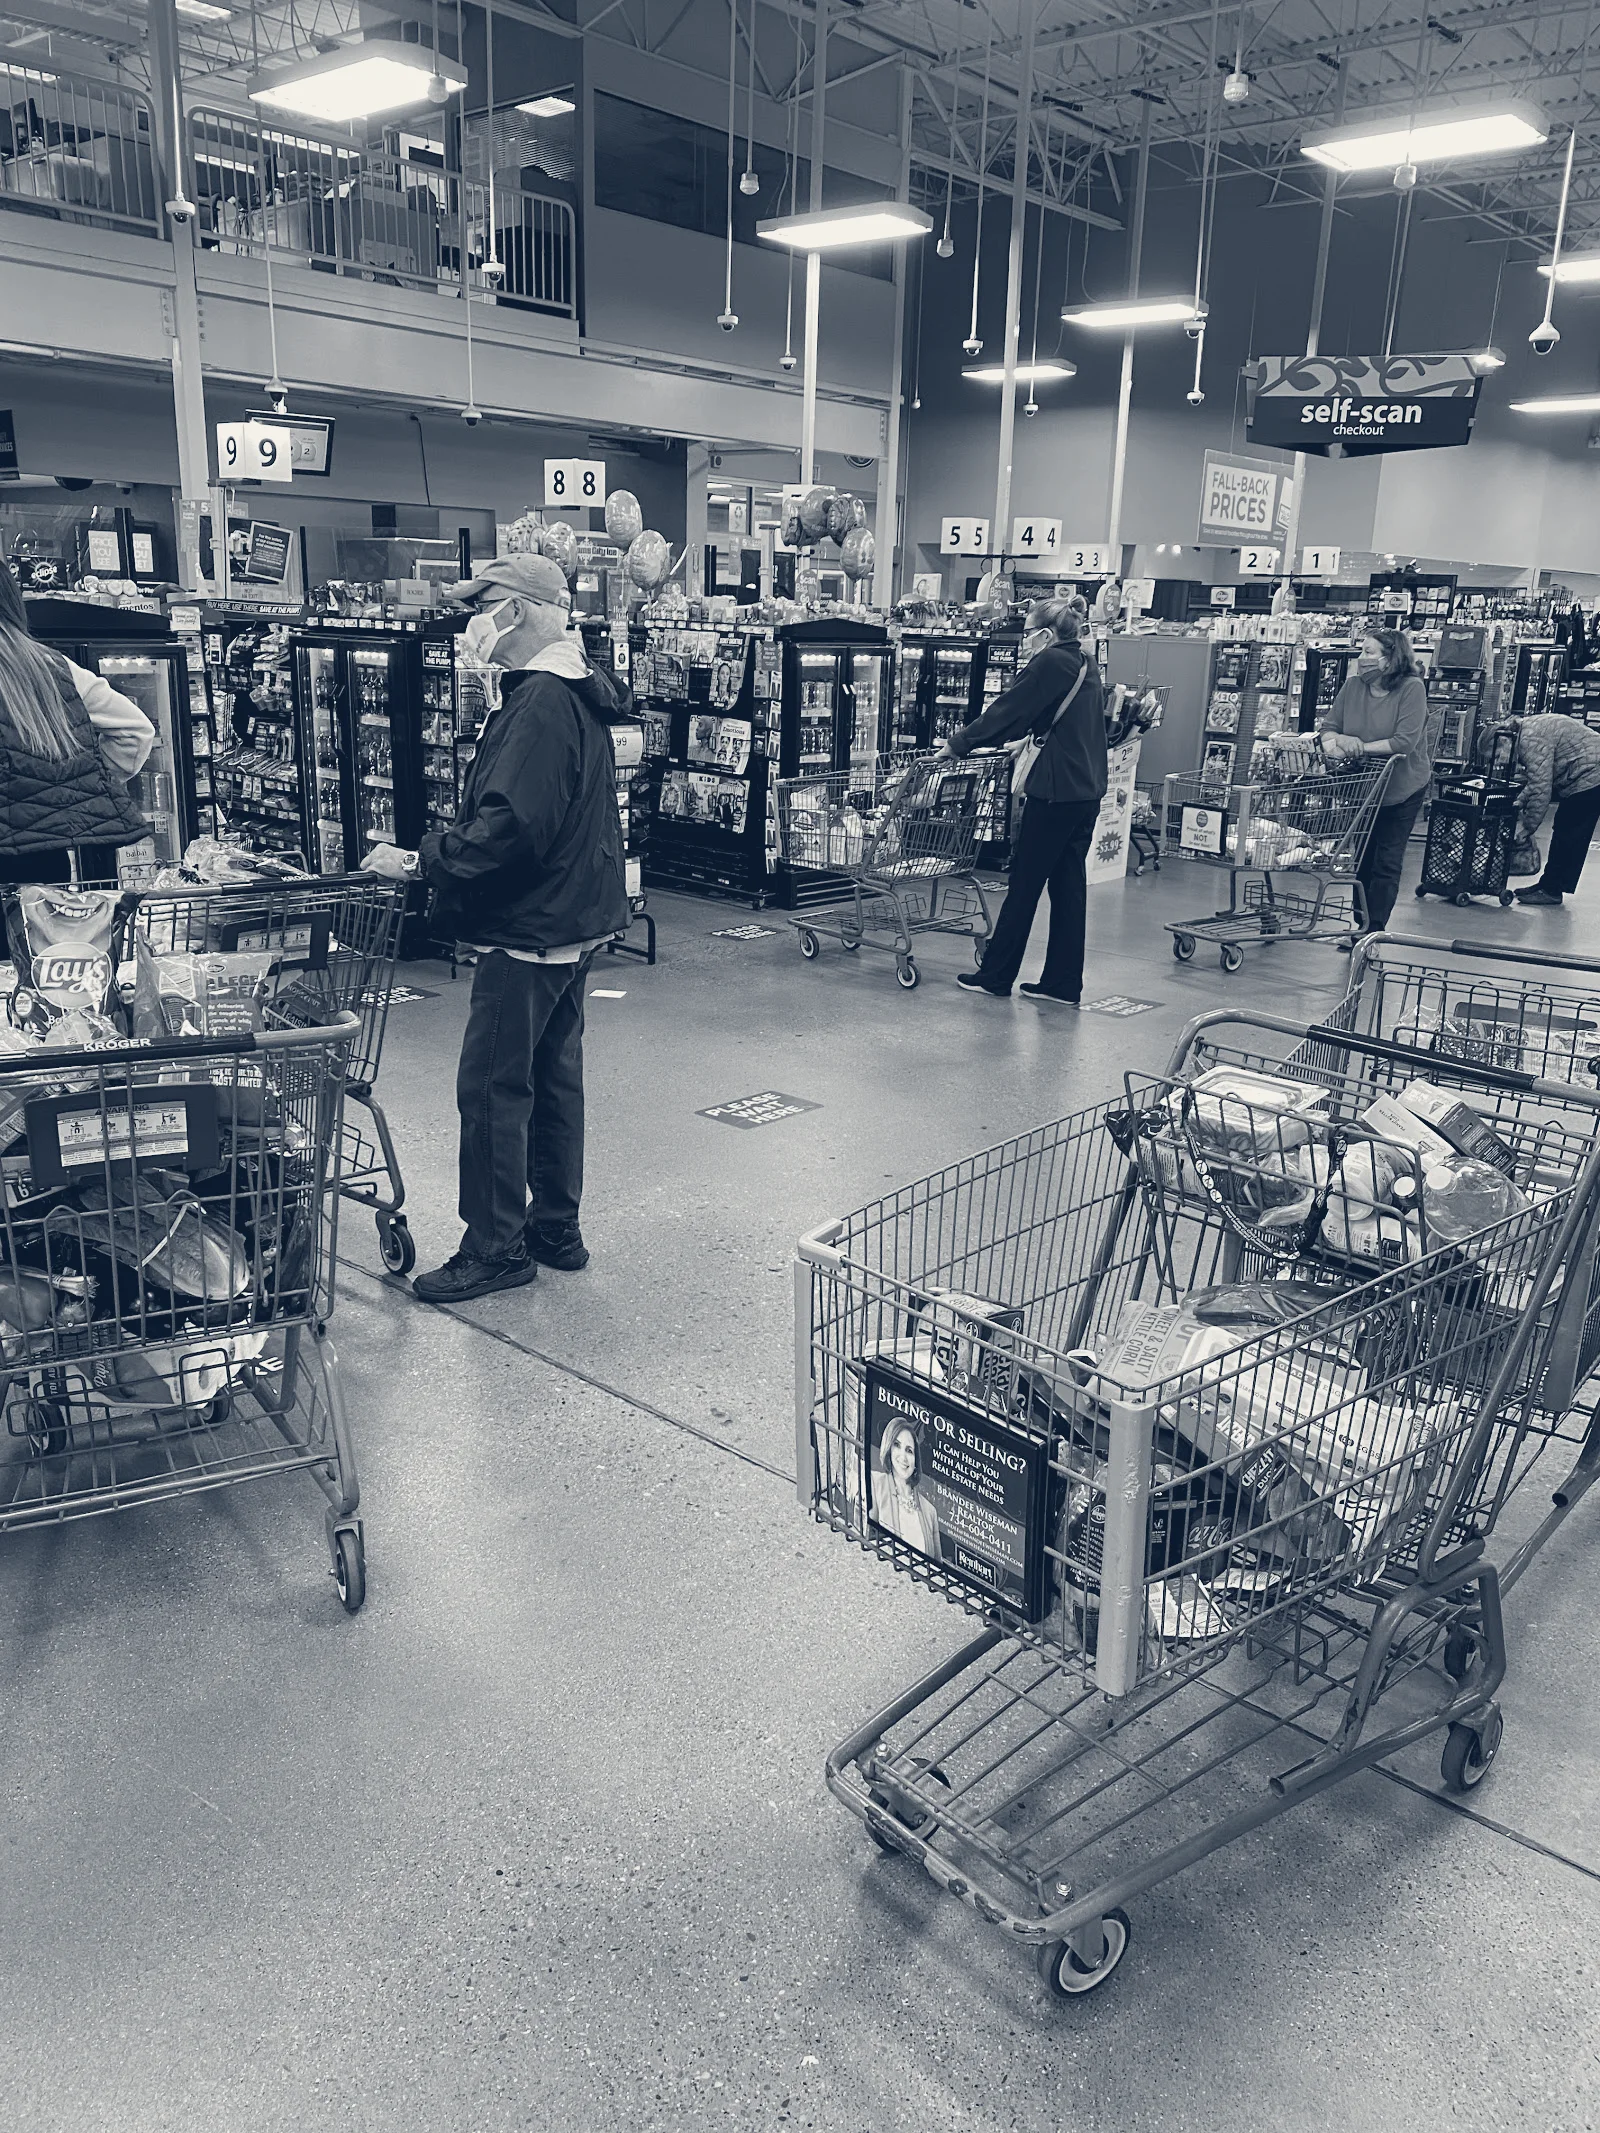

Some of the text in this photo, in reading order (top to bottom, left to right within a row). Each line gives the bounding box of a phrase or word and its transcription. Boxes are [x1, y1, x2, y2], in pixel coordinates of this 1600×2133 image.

[1300, 397, 1423, 424] self-scan
[1333, 424, 1384, 436] checkout
[226, 435, 277, 467] 9 9
[553, 469, 596, 496] 8 8
[1212, 471, 1270, 496] FALL-BACK
[1210, 491, 1267, 524] PRICES
[91, 537, 113, 547] PRICE
[949, 525, 983, 546] 5 5
[1021, 525, 1056, 548] 4 4
[93, 548, 112, 557] YOU
[592, 546, 605, 556] City
[606, 547, 617, 555] Ice
[1075, 551, 1099, 567] 3 3
[96, 557, 111, 566] SEE
[1247, 552, 1272, 568] 2 2
[1312, 552, 1336, 568] 1 1
[30, 565, 58, 579] eclipse
[800, 575, 816, 585] Scan
[994, 578, 1011, 589] Scan
[800, 594, 810, 604] Go
[993, 599, 1003, 610] Go
[425, 657, 435, 665] THE
[428, 650, 441, 658] SAVE
[1213, 691, 1239, 701] KETO
[722, 726, 746, 735] Emotions
[1193, 833, 1208, 842] NOT
[281, 873, 321, 882] KROGER
[39, 956, 107, 994] Lay's
[84, 1037, 152, 1052] KROGER
[704, 1092, 782, 1117] PLEASE
[731, 1100, 786, 1119] WAIT
[748, 1105, 805, 1124] HERE
[1120, 1311, 1159, 1367] KETTLE CORN
[1135, 1311, 1179, 1378] SWEET & SALTY
[877, 1386, 1027, 1475] BUYING OR SELLING?
[938, 1440, 1000, 1480] I CAN HELP YOU
[932, 1449, 1005, 1495] WITH ALL OF YOUR
[932, 1460, 1004, 1505] REAL ESTATE NEEDS
[937, 1484, 1018, 1536] BRANDEE WISEMAN
[949, 1512, 1012, 1555] 734-604-0411
[958, 1550, 993, 1579] Reinhart
